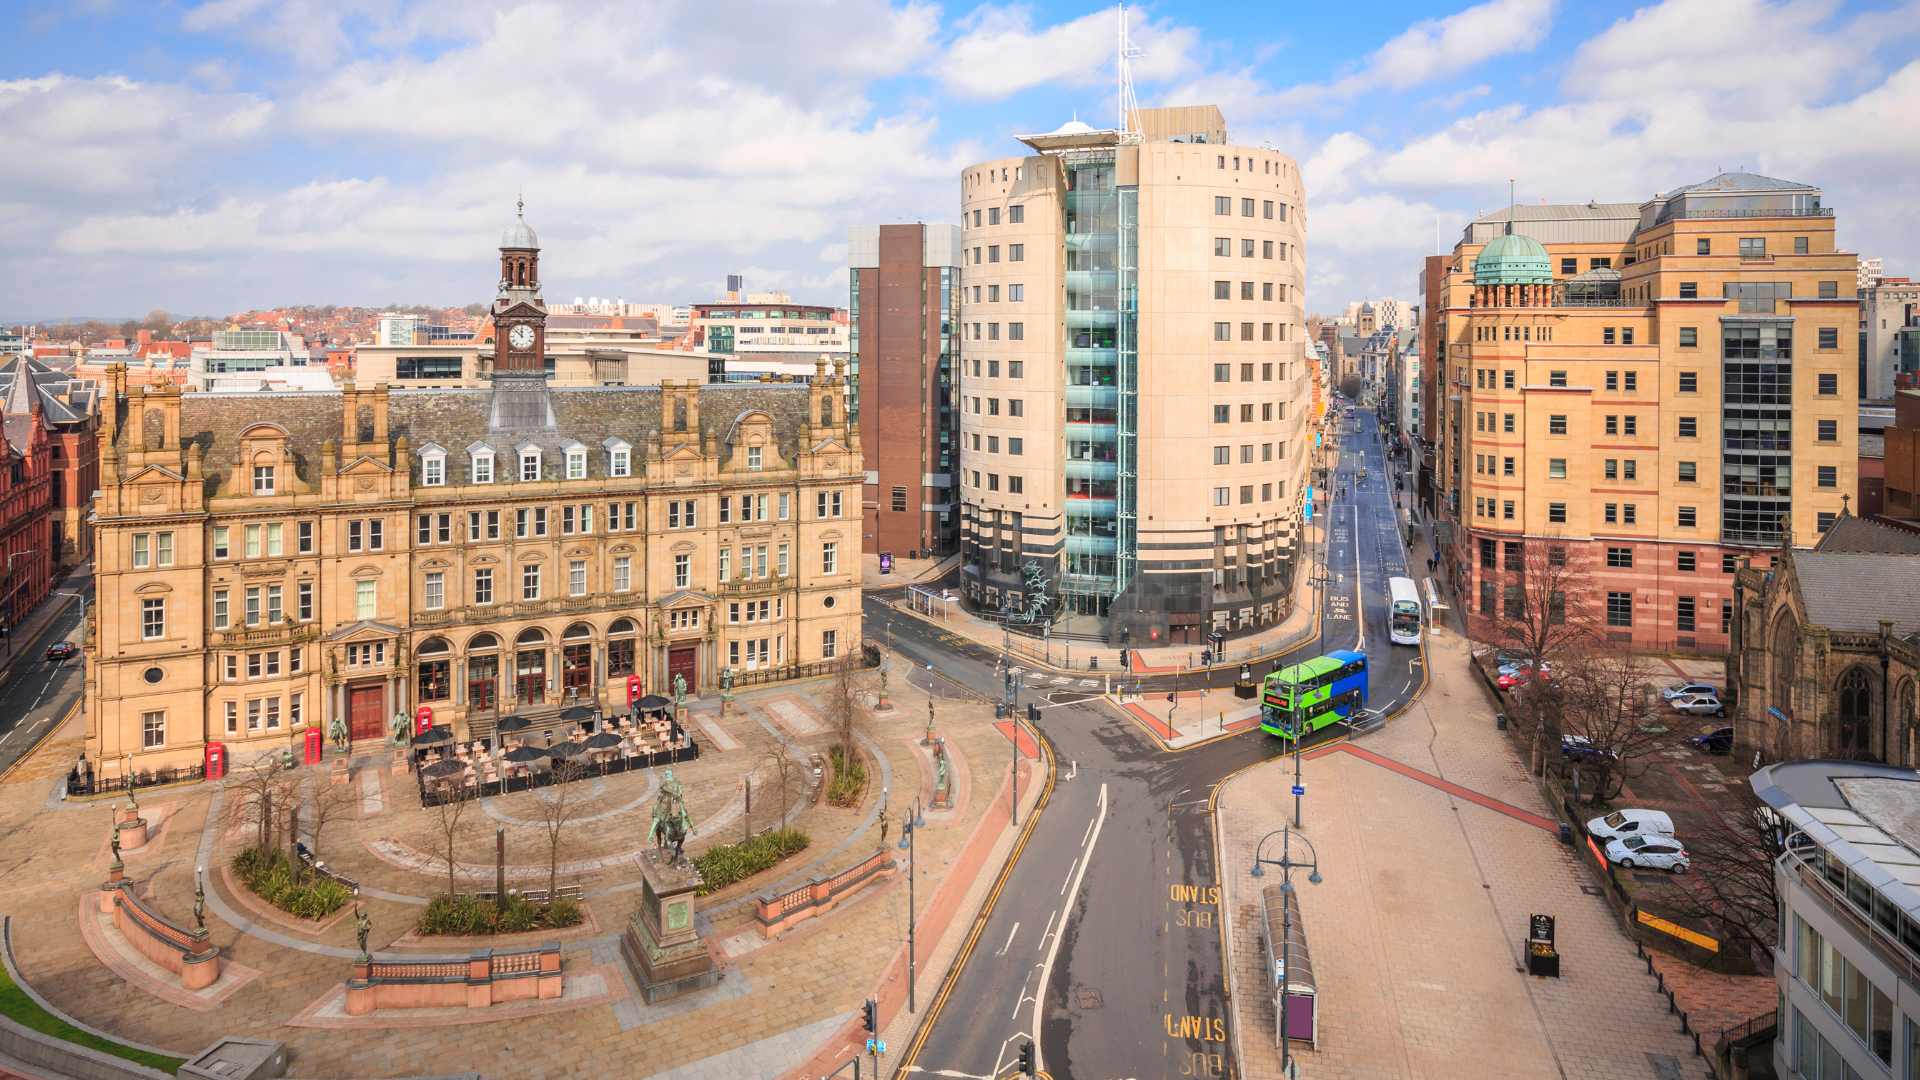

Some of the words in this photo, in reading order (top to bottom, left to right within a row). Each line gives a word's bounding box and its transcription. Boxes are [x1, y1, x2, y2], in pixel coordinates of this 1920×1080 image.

[1326, 613, 1353, 621] LANE
[1170, 884, 1218, 905] STAND
[1176, 909, 1212, 929] BUS
